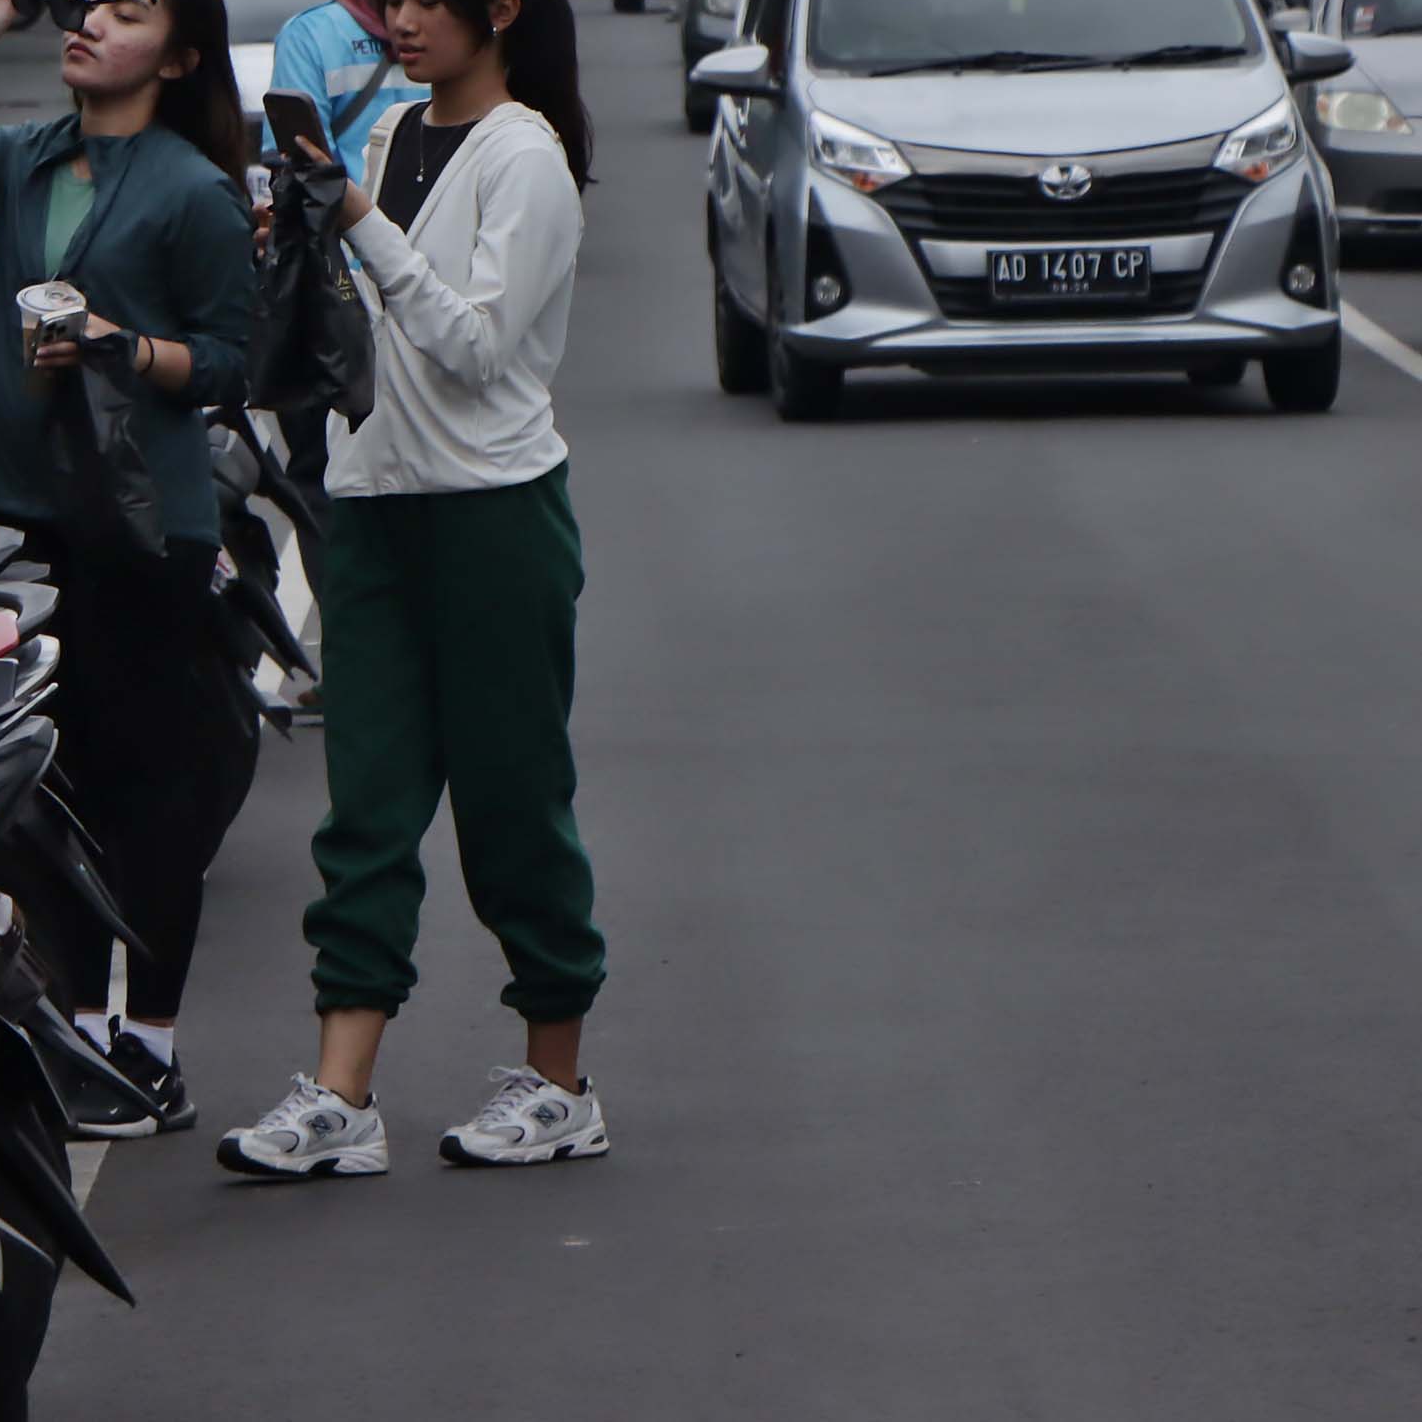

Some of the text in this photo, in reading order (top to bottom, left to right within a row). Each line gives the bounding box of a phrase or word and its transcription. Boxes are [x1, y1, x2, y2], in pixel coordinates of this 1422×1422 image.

[999, 251, 1144, 282] AD 1407 CP
